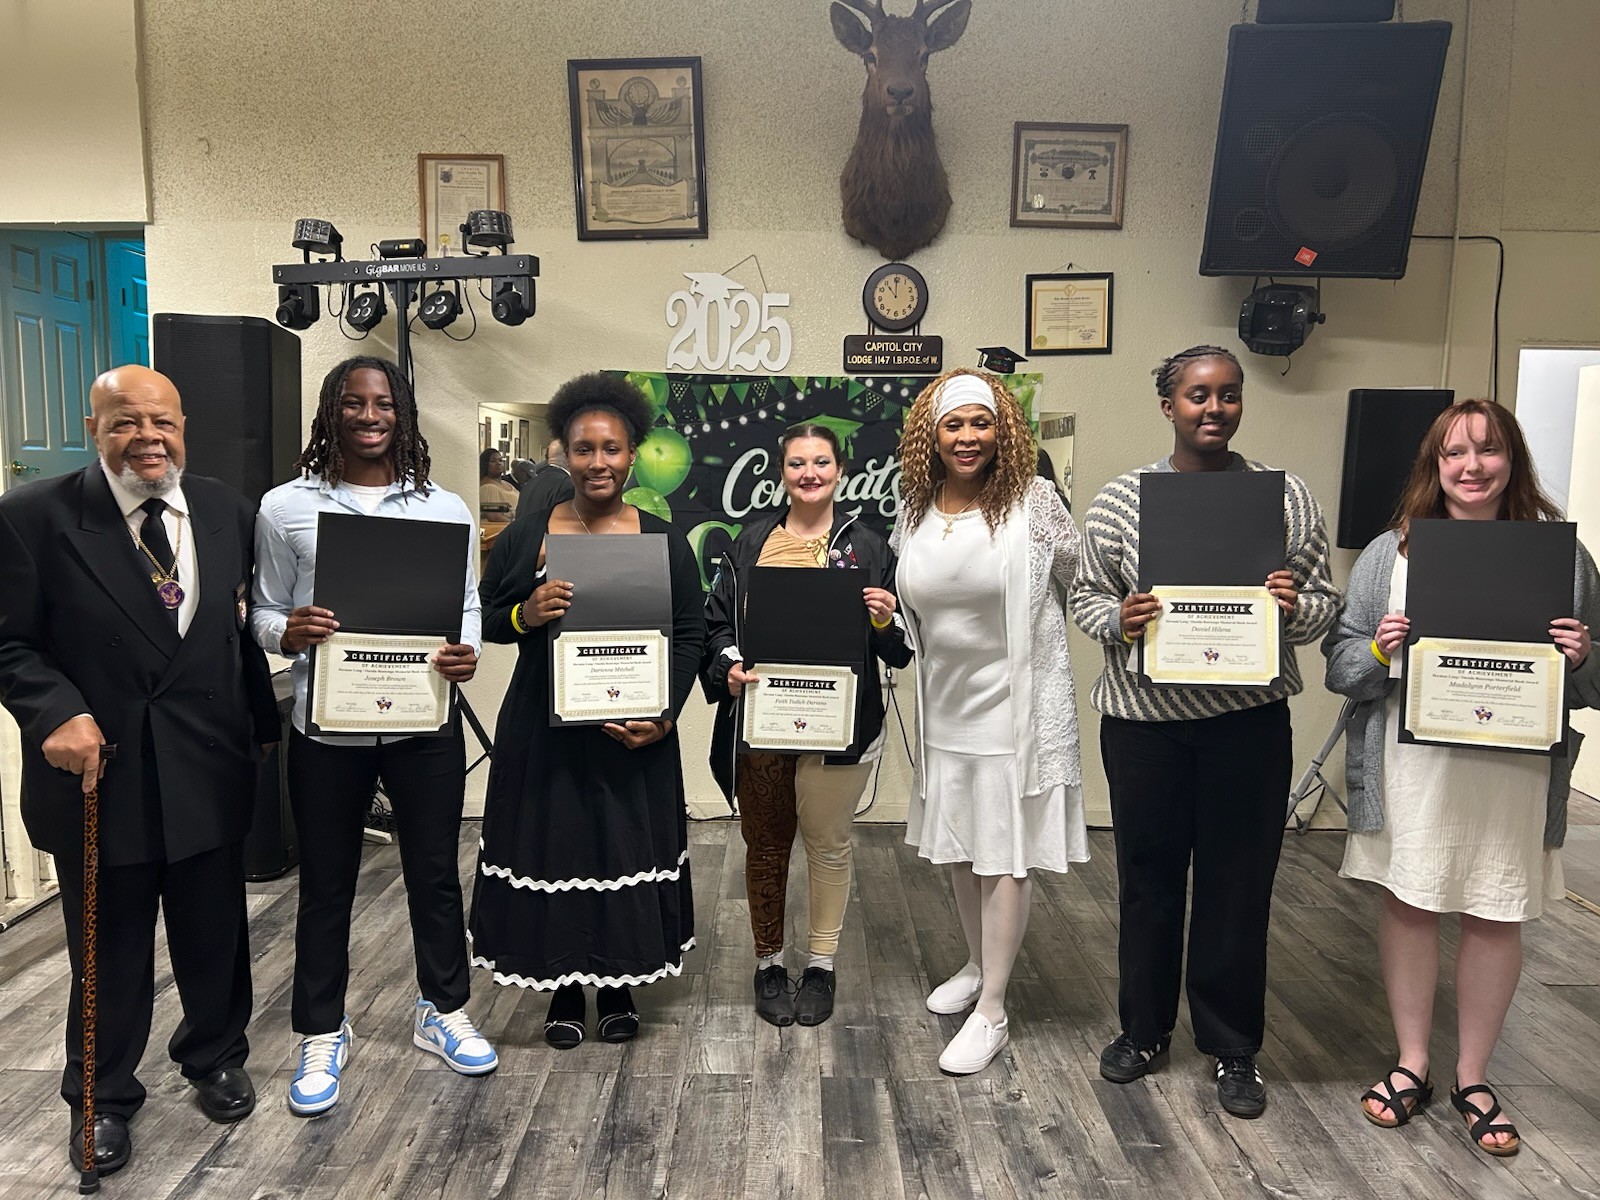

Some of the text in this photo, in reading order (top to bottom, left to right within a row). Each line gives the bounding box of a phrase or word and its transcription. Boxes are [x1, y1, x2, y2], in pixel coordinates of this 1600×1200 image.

[665, 290, 792, 373] 2025
[864, 342, 924, 352] CAPITOL CITY
[847, 355, 873, 364] LODGE
[874, 355, 890, 364] 1147
[1177, 604, 1246, 613] CERTIFICATE
[582, 647, 642, 655] CERTIFICATE
[351, 653, 421, 662] CERTIFICATE
[1446, 658, 1526, 671] CERTIFICATE
[1467, 670, 1513, 678] ACHIEVEMENT
[773, 680, 831, 688] CERTIFICATE
[1484, 683, 1521, 692] Porterfield
